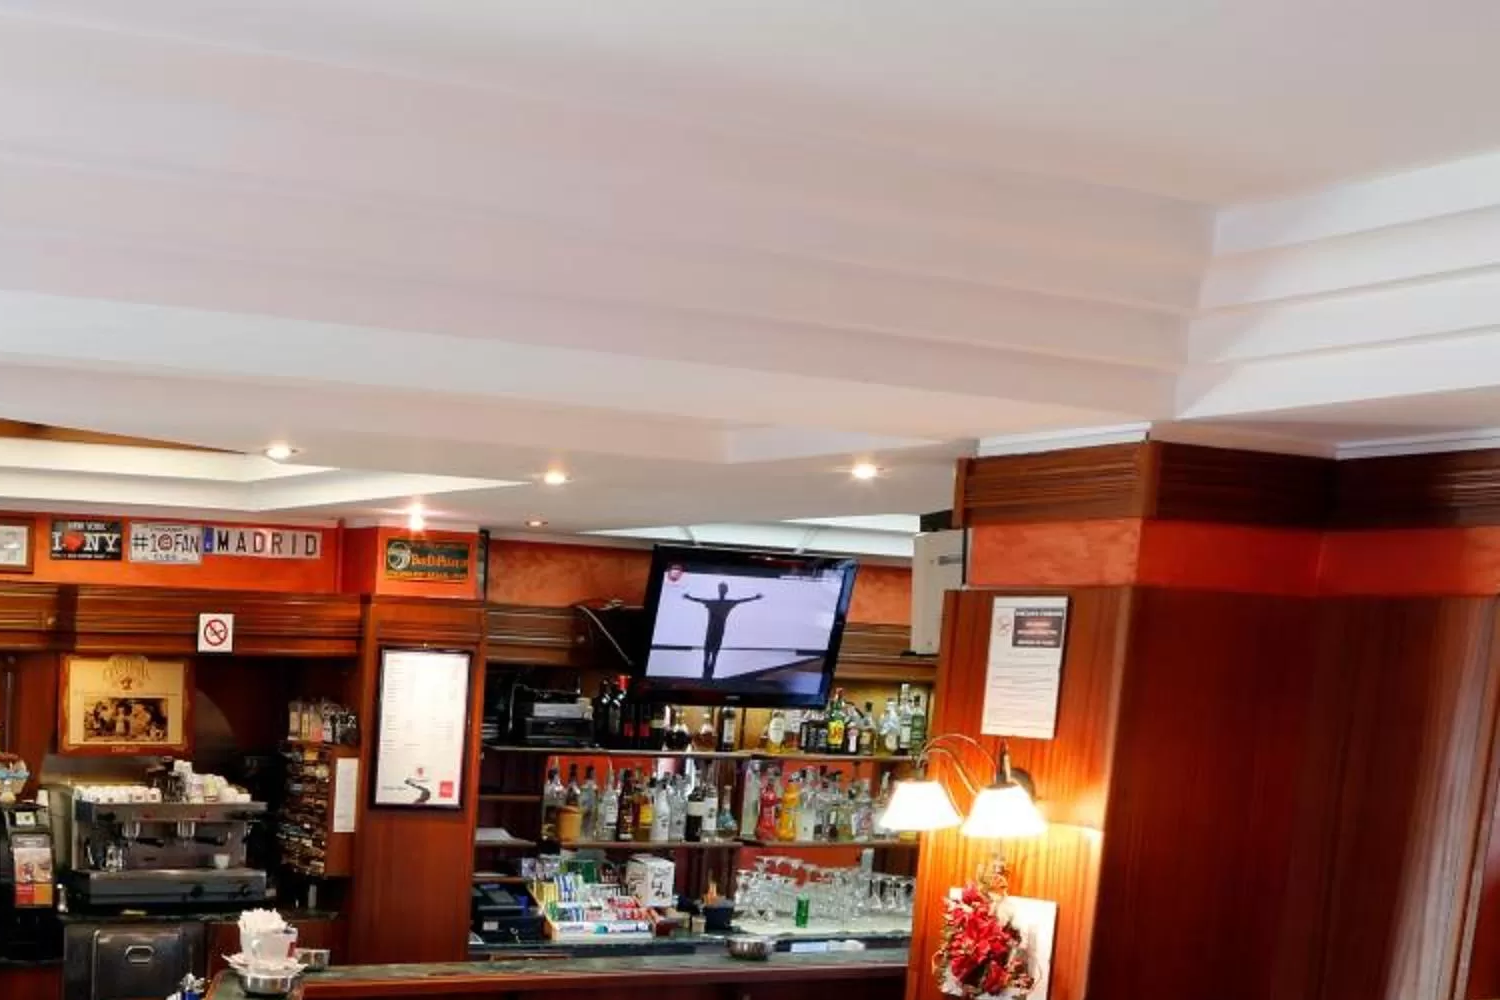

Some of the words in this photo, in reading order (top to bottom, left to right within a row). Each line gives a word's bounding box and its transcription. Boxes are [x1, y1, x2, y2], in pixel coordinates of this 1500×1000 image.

[84, 532, 121, 552] NY
[174, 533, 200, 553] FAN
[217, 530, 317, 556] MADRID
